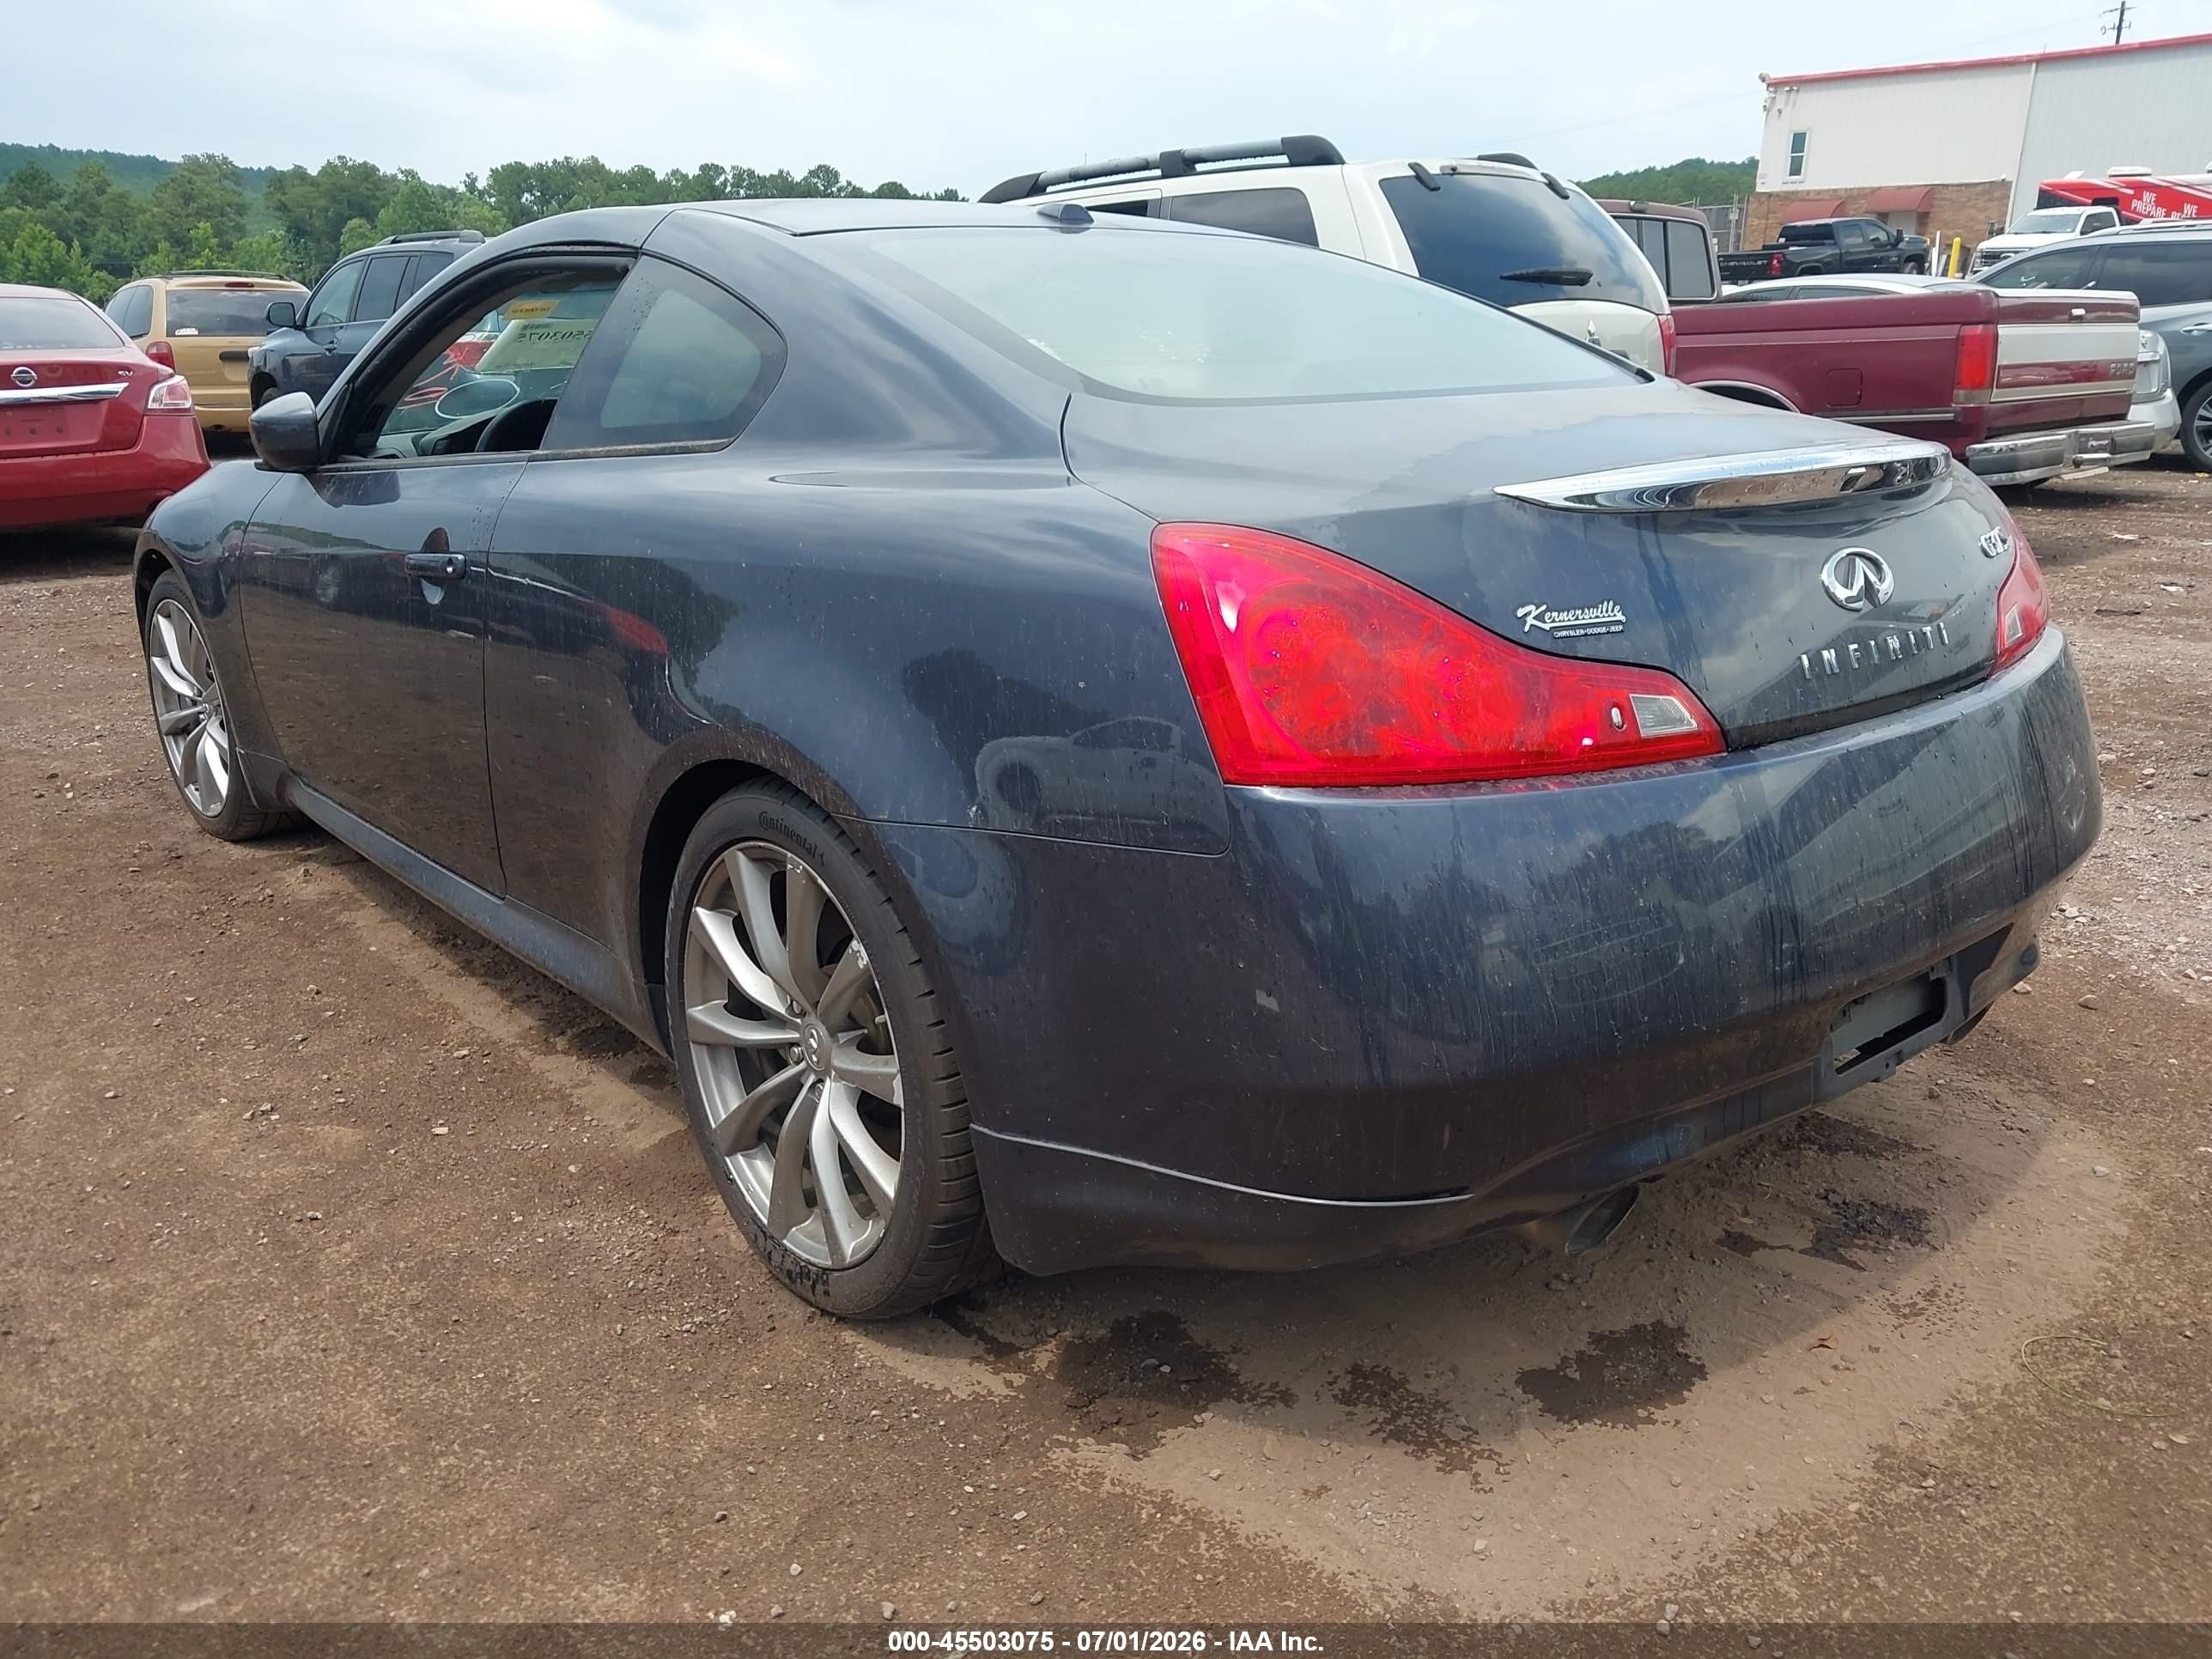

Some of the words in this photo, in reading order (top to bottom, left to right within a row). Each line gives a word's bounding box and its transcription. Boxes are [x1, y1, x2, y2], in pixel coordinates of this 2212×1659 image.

[2130, 198, 2168, 219] PREPARE
[2142, 190, 2158, 205] WE
[2183, 202, 2199, 218] WE
[1516, 599, 1626, 633] Kernersville
[1799, 622, 1950, 680] INFINITI
[758, 810, 818, 860] Continental
